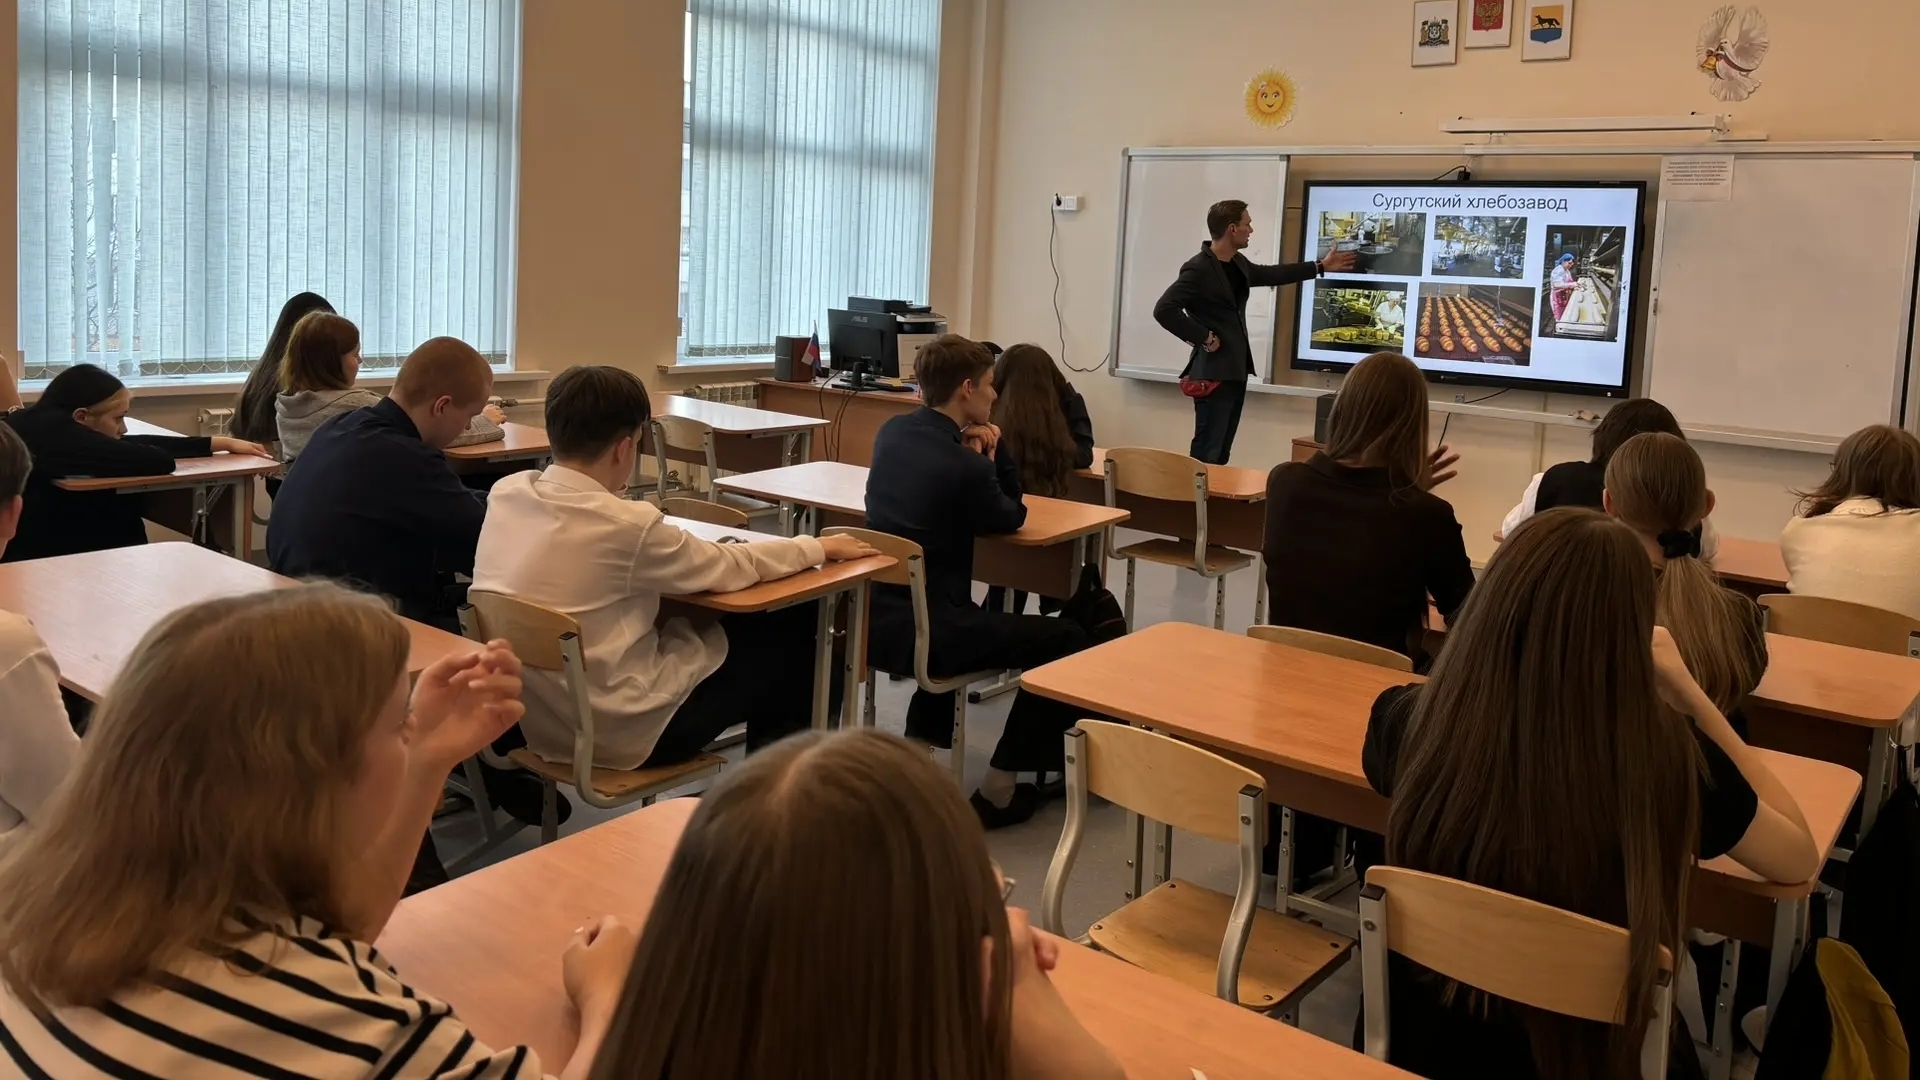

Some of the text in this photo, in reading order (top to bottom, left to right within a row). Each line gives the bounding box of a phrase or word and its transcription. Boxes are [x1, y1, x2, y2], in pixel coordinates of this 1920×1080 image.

[1373, 193, 1568, 212] Сургутский хлебозавод
[851, 315, 868, 323] ASUS
